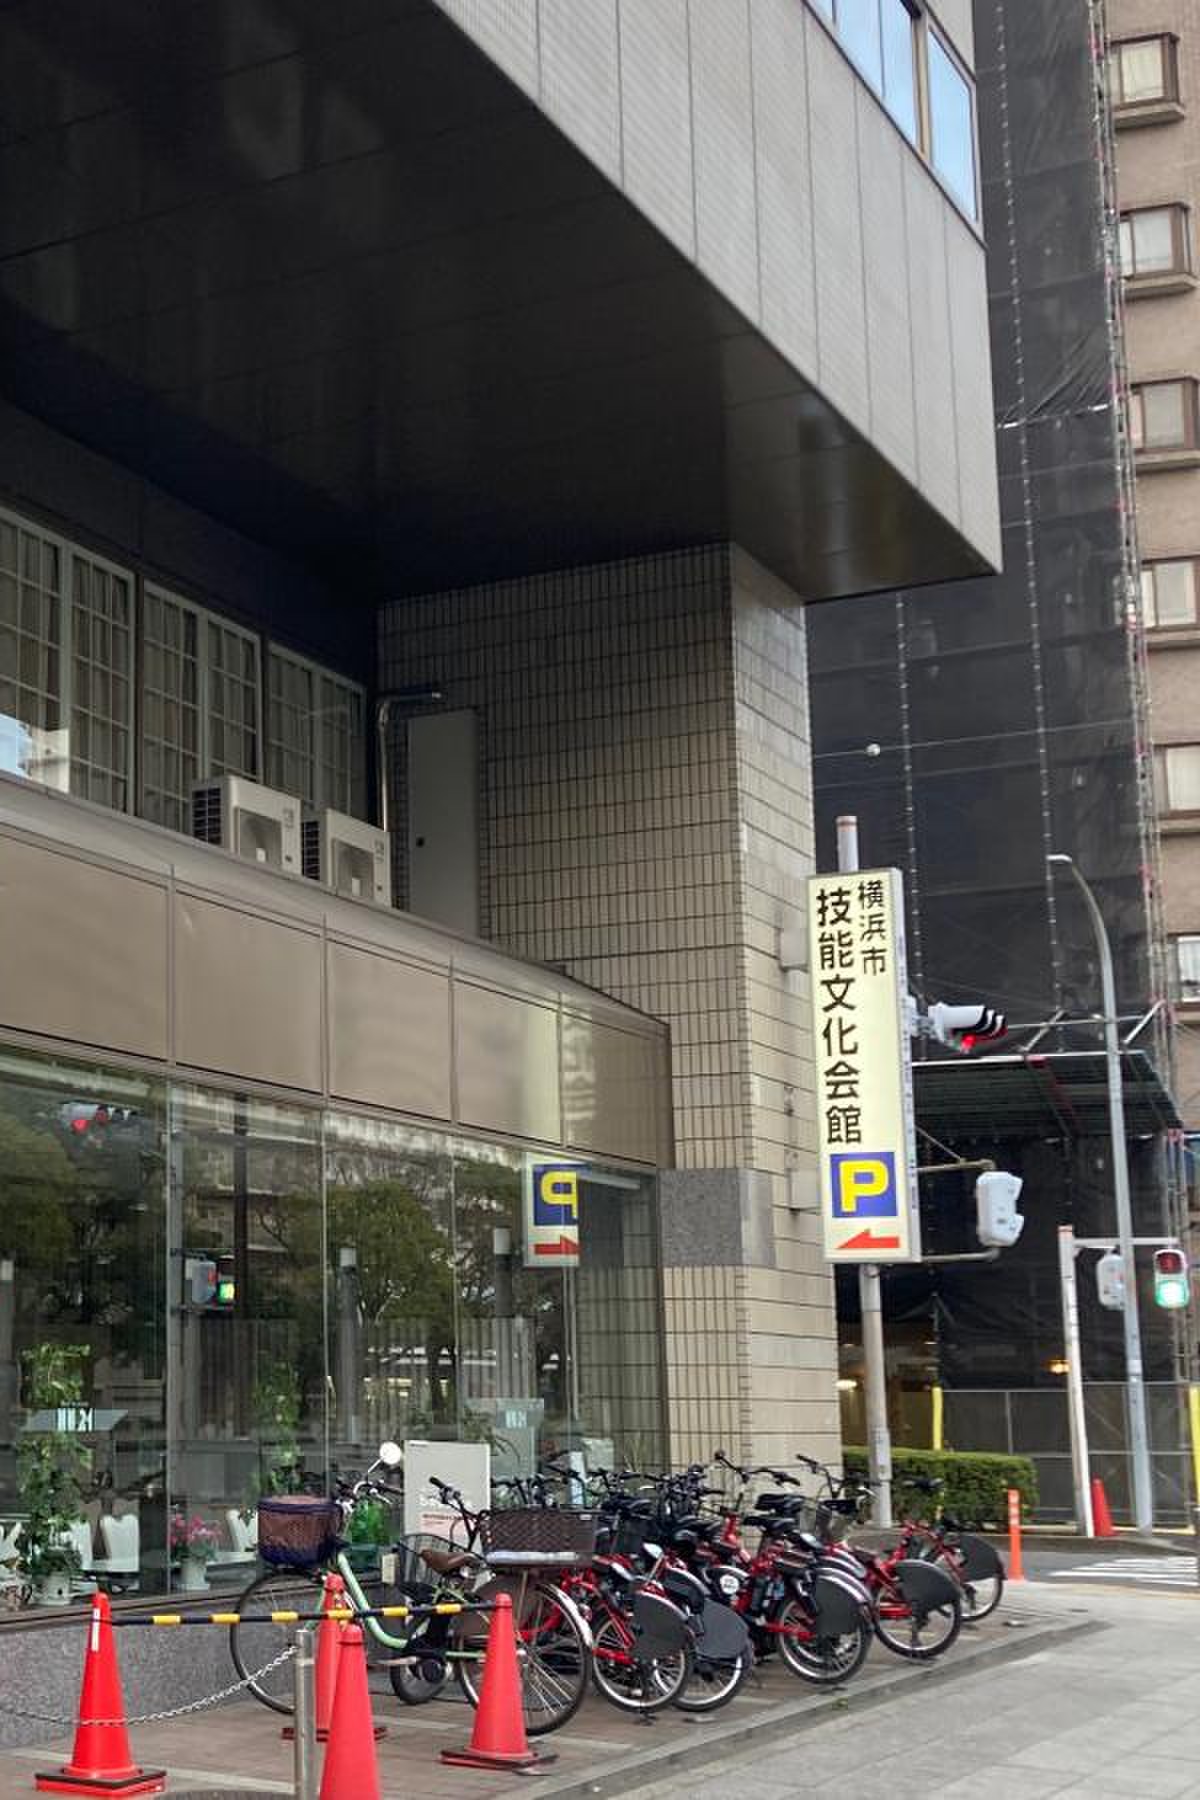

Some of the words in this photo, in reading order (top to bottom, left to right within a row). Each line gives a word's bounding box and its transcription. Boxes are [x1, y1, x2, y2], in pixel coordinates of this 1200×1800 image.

[857, 879, 887, 975] 横浜市
[816, 888, 863, 1144] 技能文化会館
[838, 1160, 890, 1213] P
